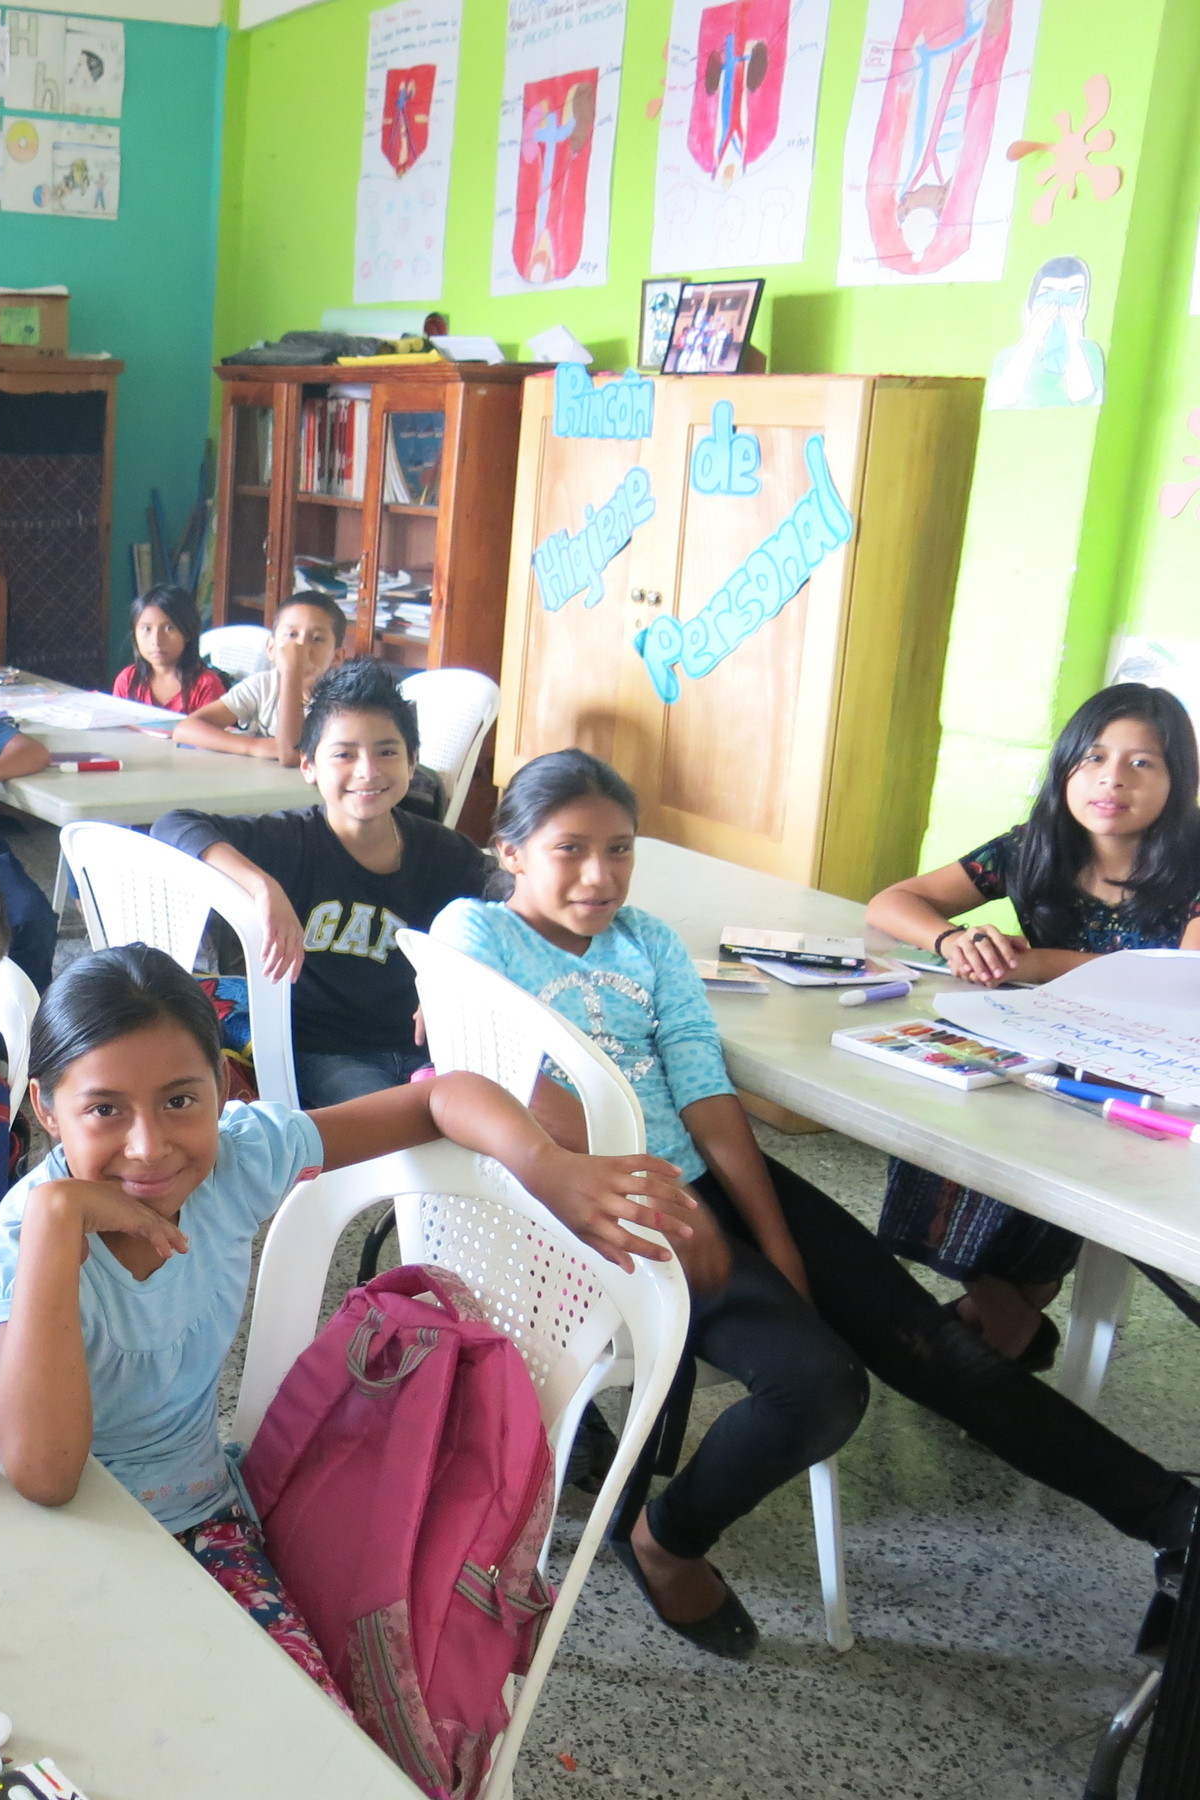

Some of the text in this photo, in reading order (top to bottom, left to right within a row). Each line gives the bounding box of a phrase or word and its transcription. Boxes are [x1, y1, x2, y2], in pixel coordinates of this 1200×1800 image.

[693, 401, 760, 495] de
[535, 467, 655, 609] Higiene
[636, 434, 852, 703] Personal
[303, 900, 408, 965] GAP
